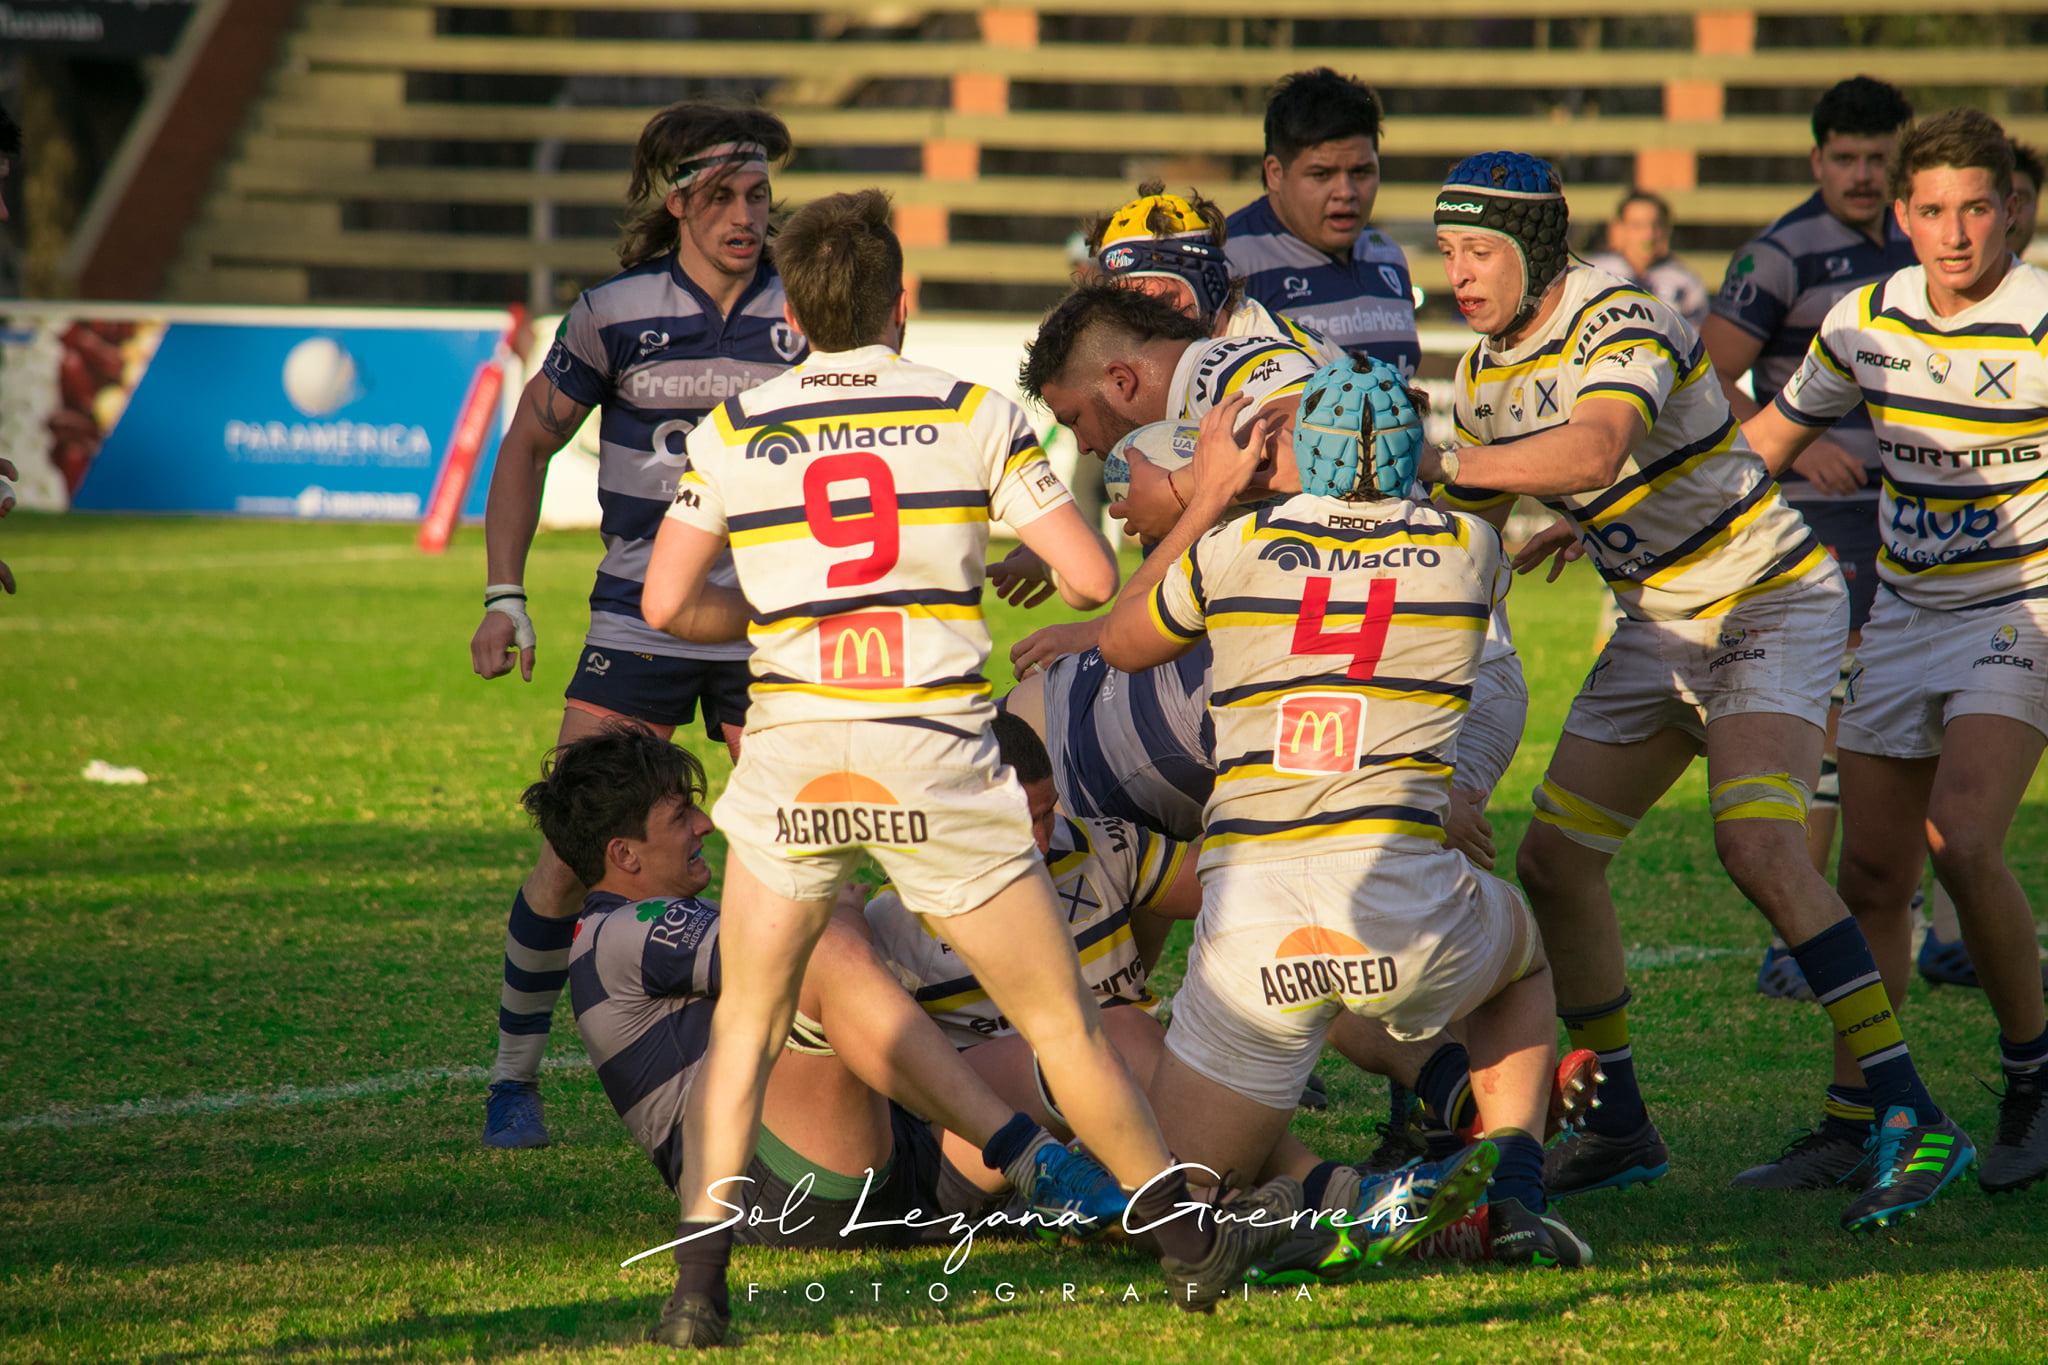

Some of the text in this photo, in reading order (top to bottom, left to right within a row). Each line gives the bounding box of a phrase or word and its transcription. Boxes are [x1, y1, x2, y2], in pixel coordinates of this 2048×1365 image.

[1856, 350, 1912, 372] PROCER
[800, 373, 878, 389] PROCER
[818, 422, 939, 451] Macro
[803, 451, 900, 588] 9
[1328, 547, 1441, 572] Macro
[1290, 576, 1397, 680] 4
[1709, 648, 1766, 673] PROCER
[1972, 654, 2034, 671] PROCER
[775, 807, 928, 845] AGROSEED
[1260, 956, 1398, 1006] AGROSEED
[1838, 1009, 1892, 1038] ROCER
